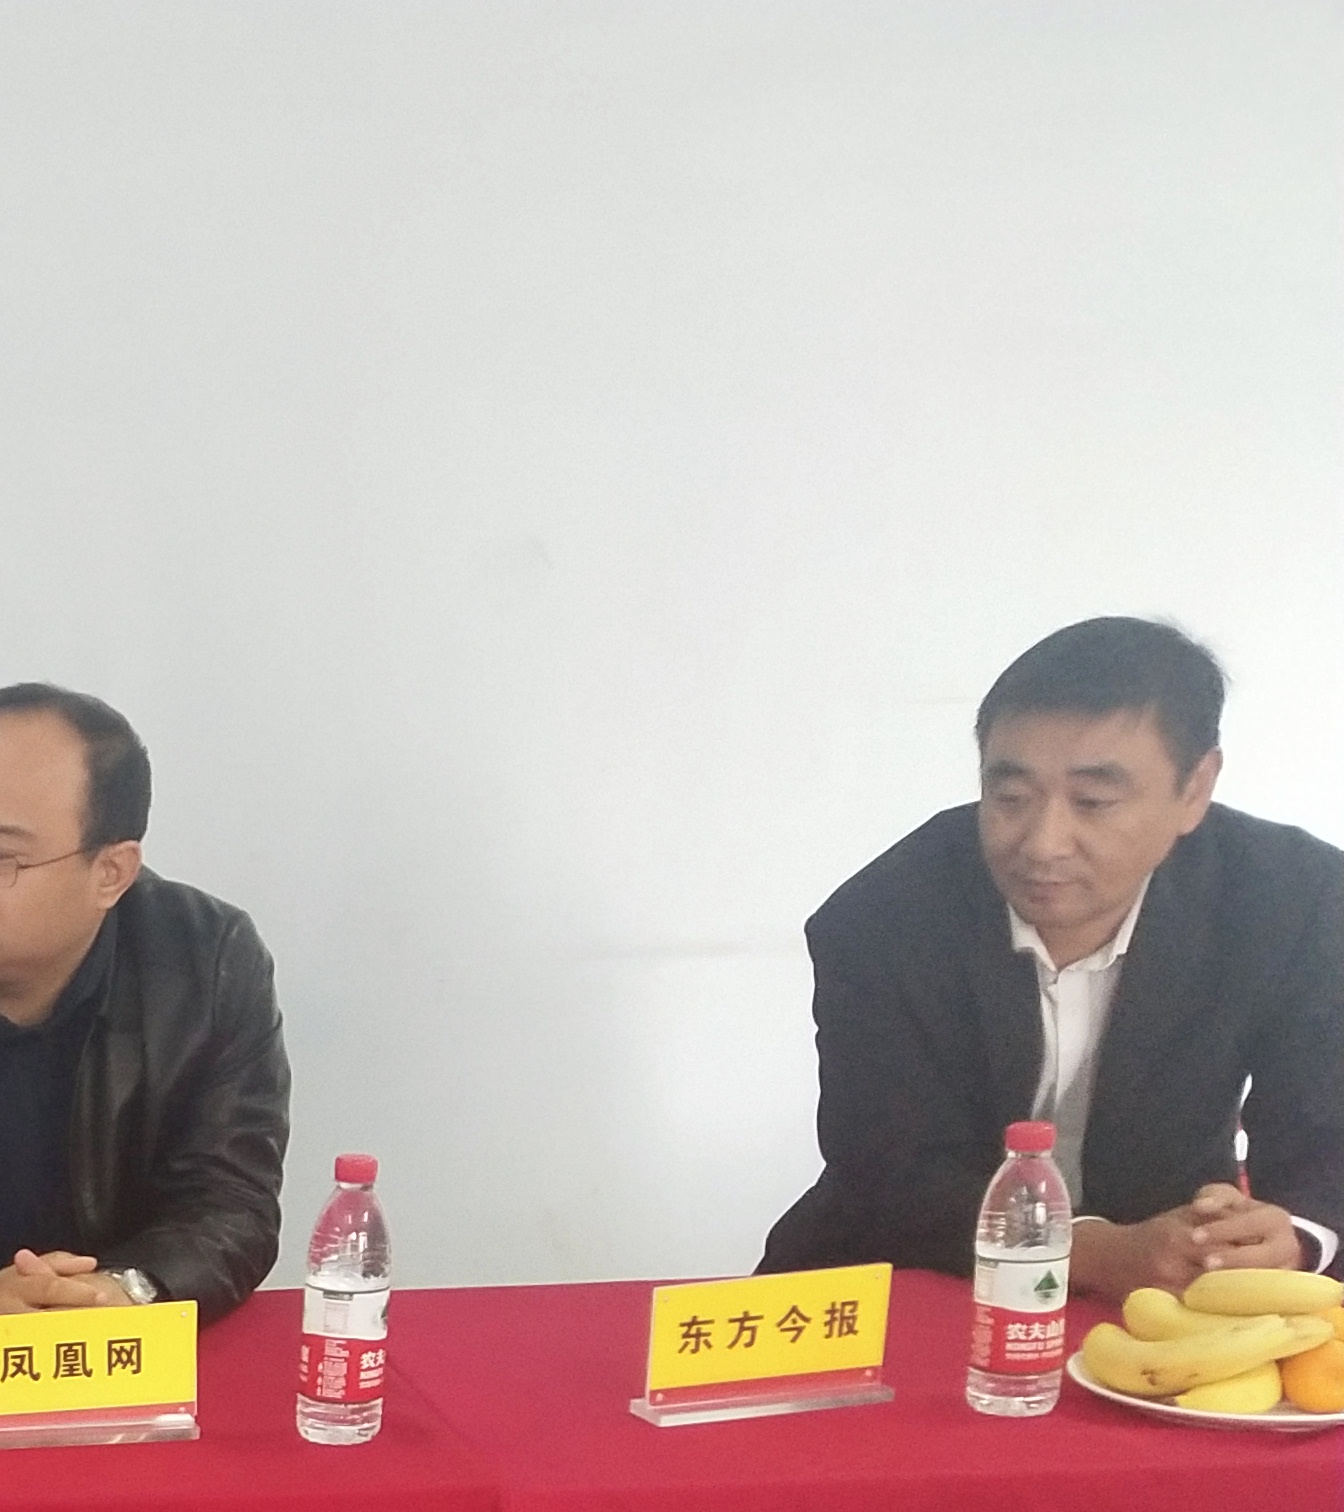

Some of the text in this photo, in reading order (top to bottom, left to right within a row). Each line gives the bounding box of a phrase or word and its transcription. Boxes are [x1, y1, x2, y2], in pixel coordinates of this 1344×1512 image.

[678, 1301, 859, 1354] 东方今报
[0, 1338, 142, 1383] 凤凰网
